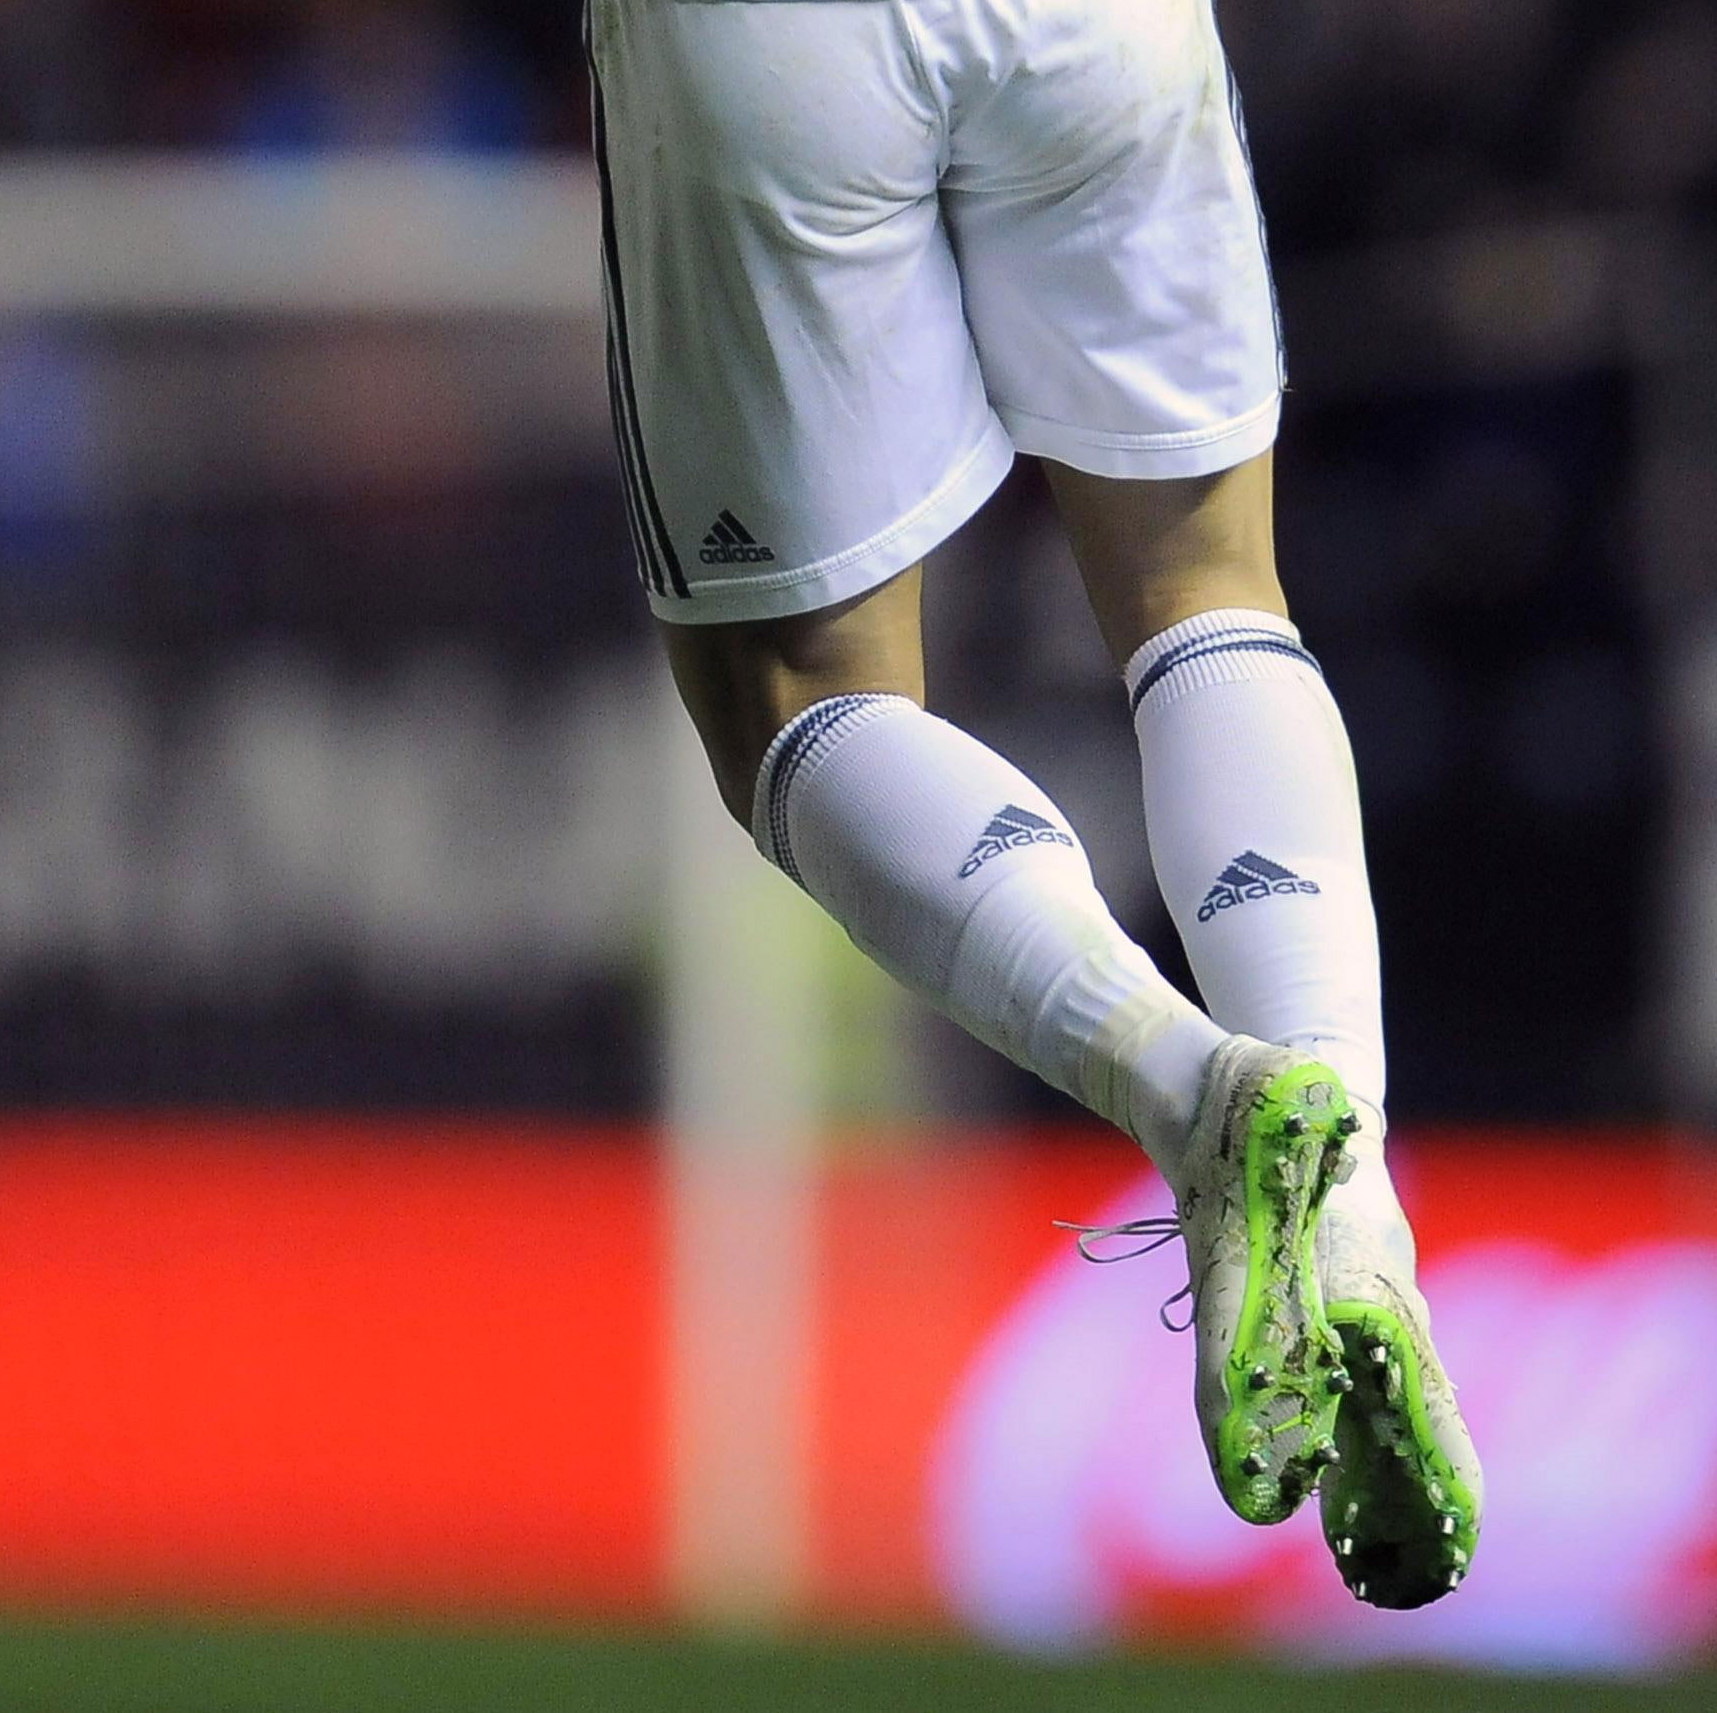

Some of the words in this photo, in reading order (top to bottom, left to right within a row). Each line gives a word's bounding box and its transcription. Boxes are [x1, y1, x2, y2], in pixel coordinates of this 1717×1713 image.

[699, 543, 775, 564] adidas
[958, 829, 1074, 879] adidas
[1197, 878, 1321, 923] adidas
